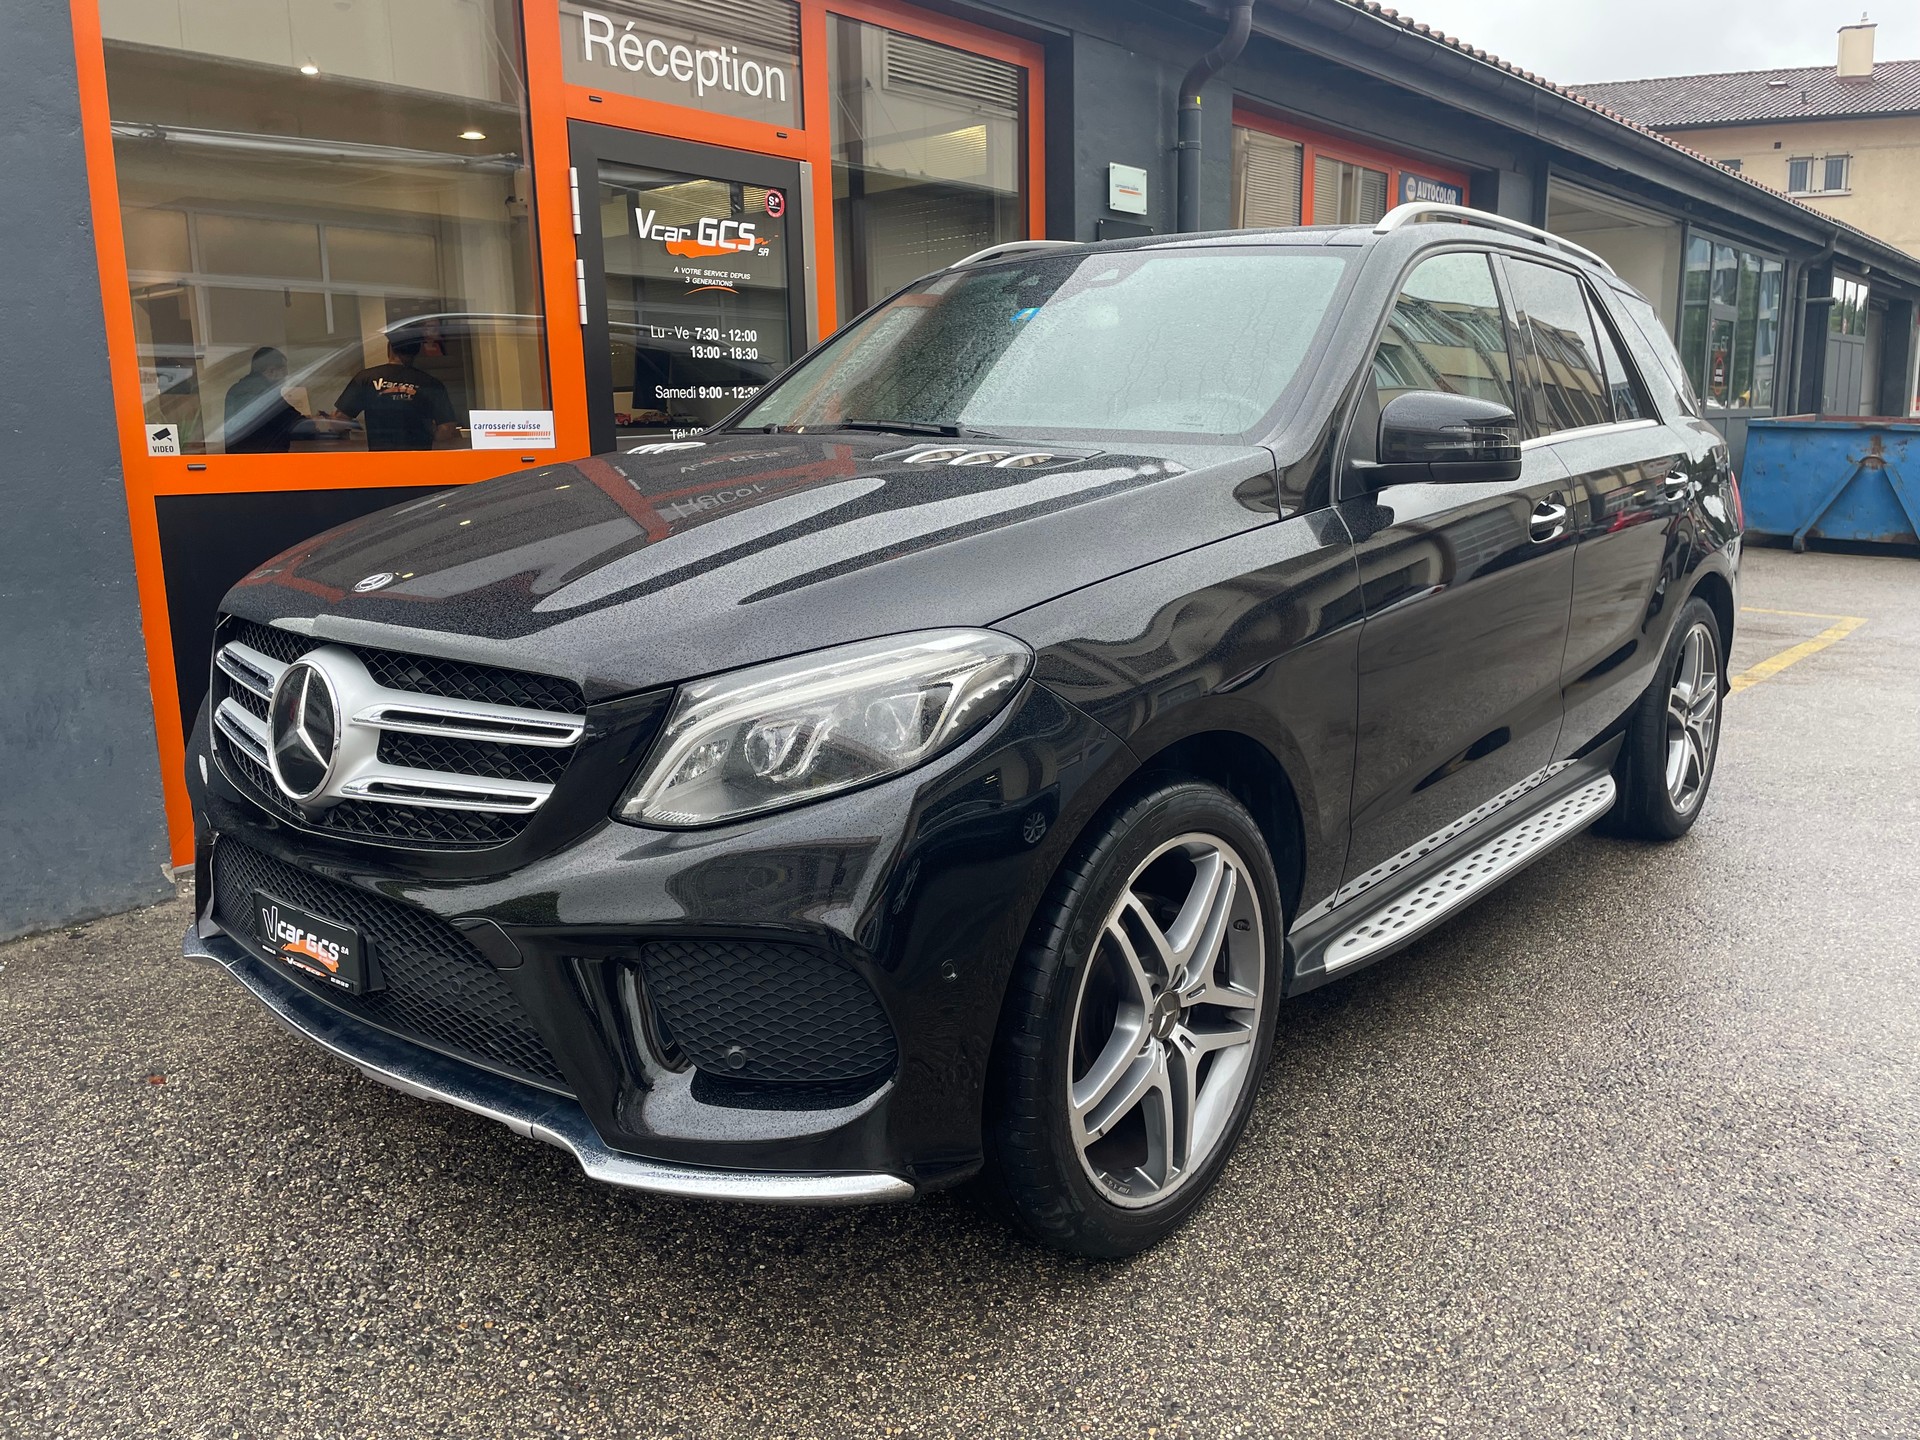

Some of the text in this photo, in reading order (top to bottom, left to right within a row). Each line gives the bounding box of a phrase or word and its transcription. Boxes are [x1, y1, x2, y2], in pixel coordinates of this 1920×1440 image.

[582, 10, 786, 101] Réception
[1417, 181, 1457, 205] AUTOCOLOR
[634, 207, 770, 256] Vcar GCS SA
[680, 267, 702, 275] VOTRE
[703, 269, 729, 278] SERVICE
[729, 271, 751, 280] DEPUIS
[692, 277, 733, 287] GENERATIONS
[650, 325, 665, 338] Lu
[674, 326, 690, 339] Ve
[694, 327, 719, 341] 7:30
[728, 328, 758, 342] 12:00
[690, 345, 720, 359] 13:00
[729, 347, 758, 360] 18:30
[655, 385, 697, 399] Samedi
[698, 386, 722, 399] 9:00
[473, 420, 541, 430] carrosserie suisse
[152, 445, 174, 453] VIDEO
[261, 905, 350, 962] Vcar GCS SA
